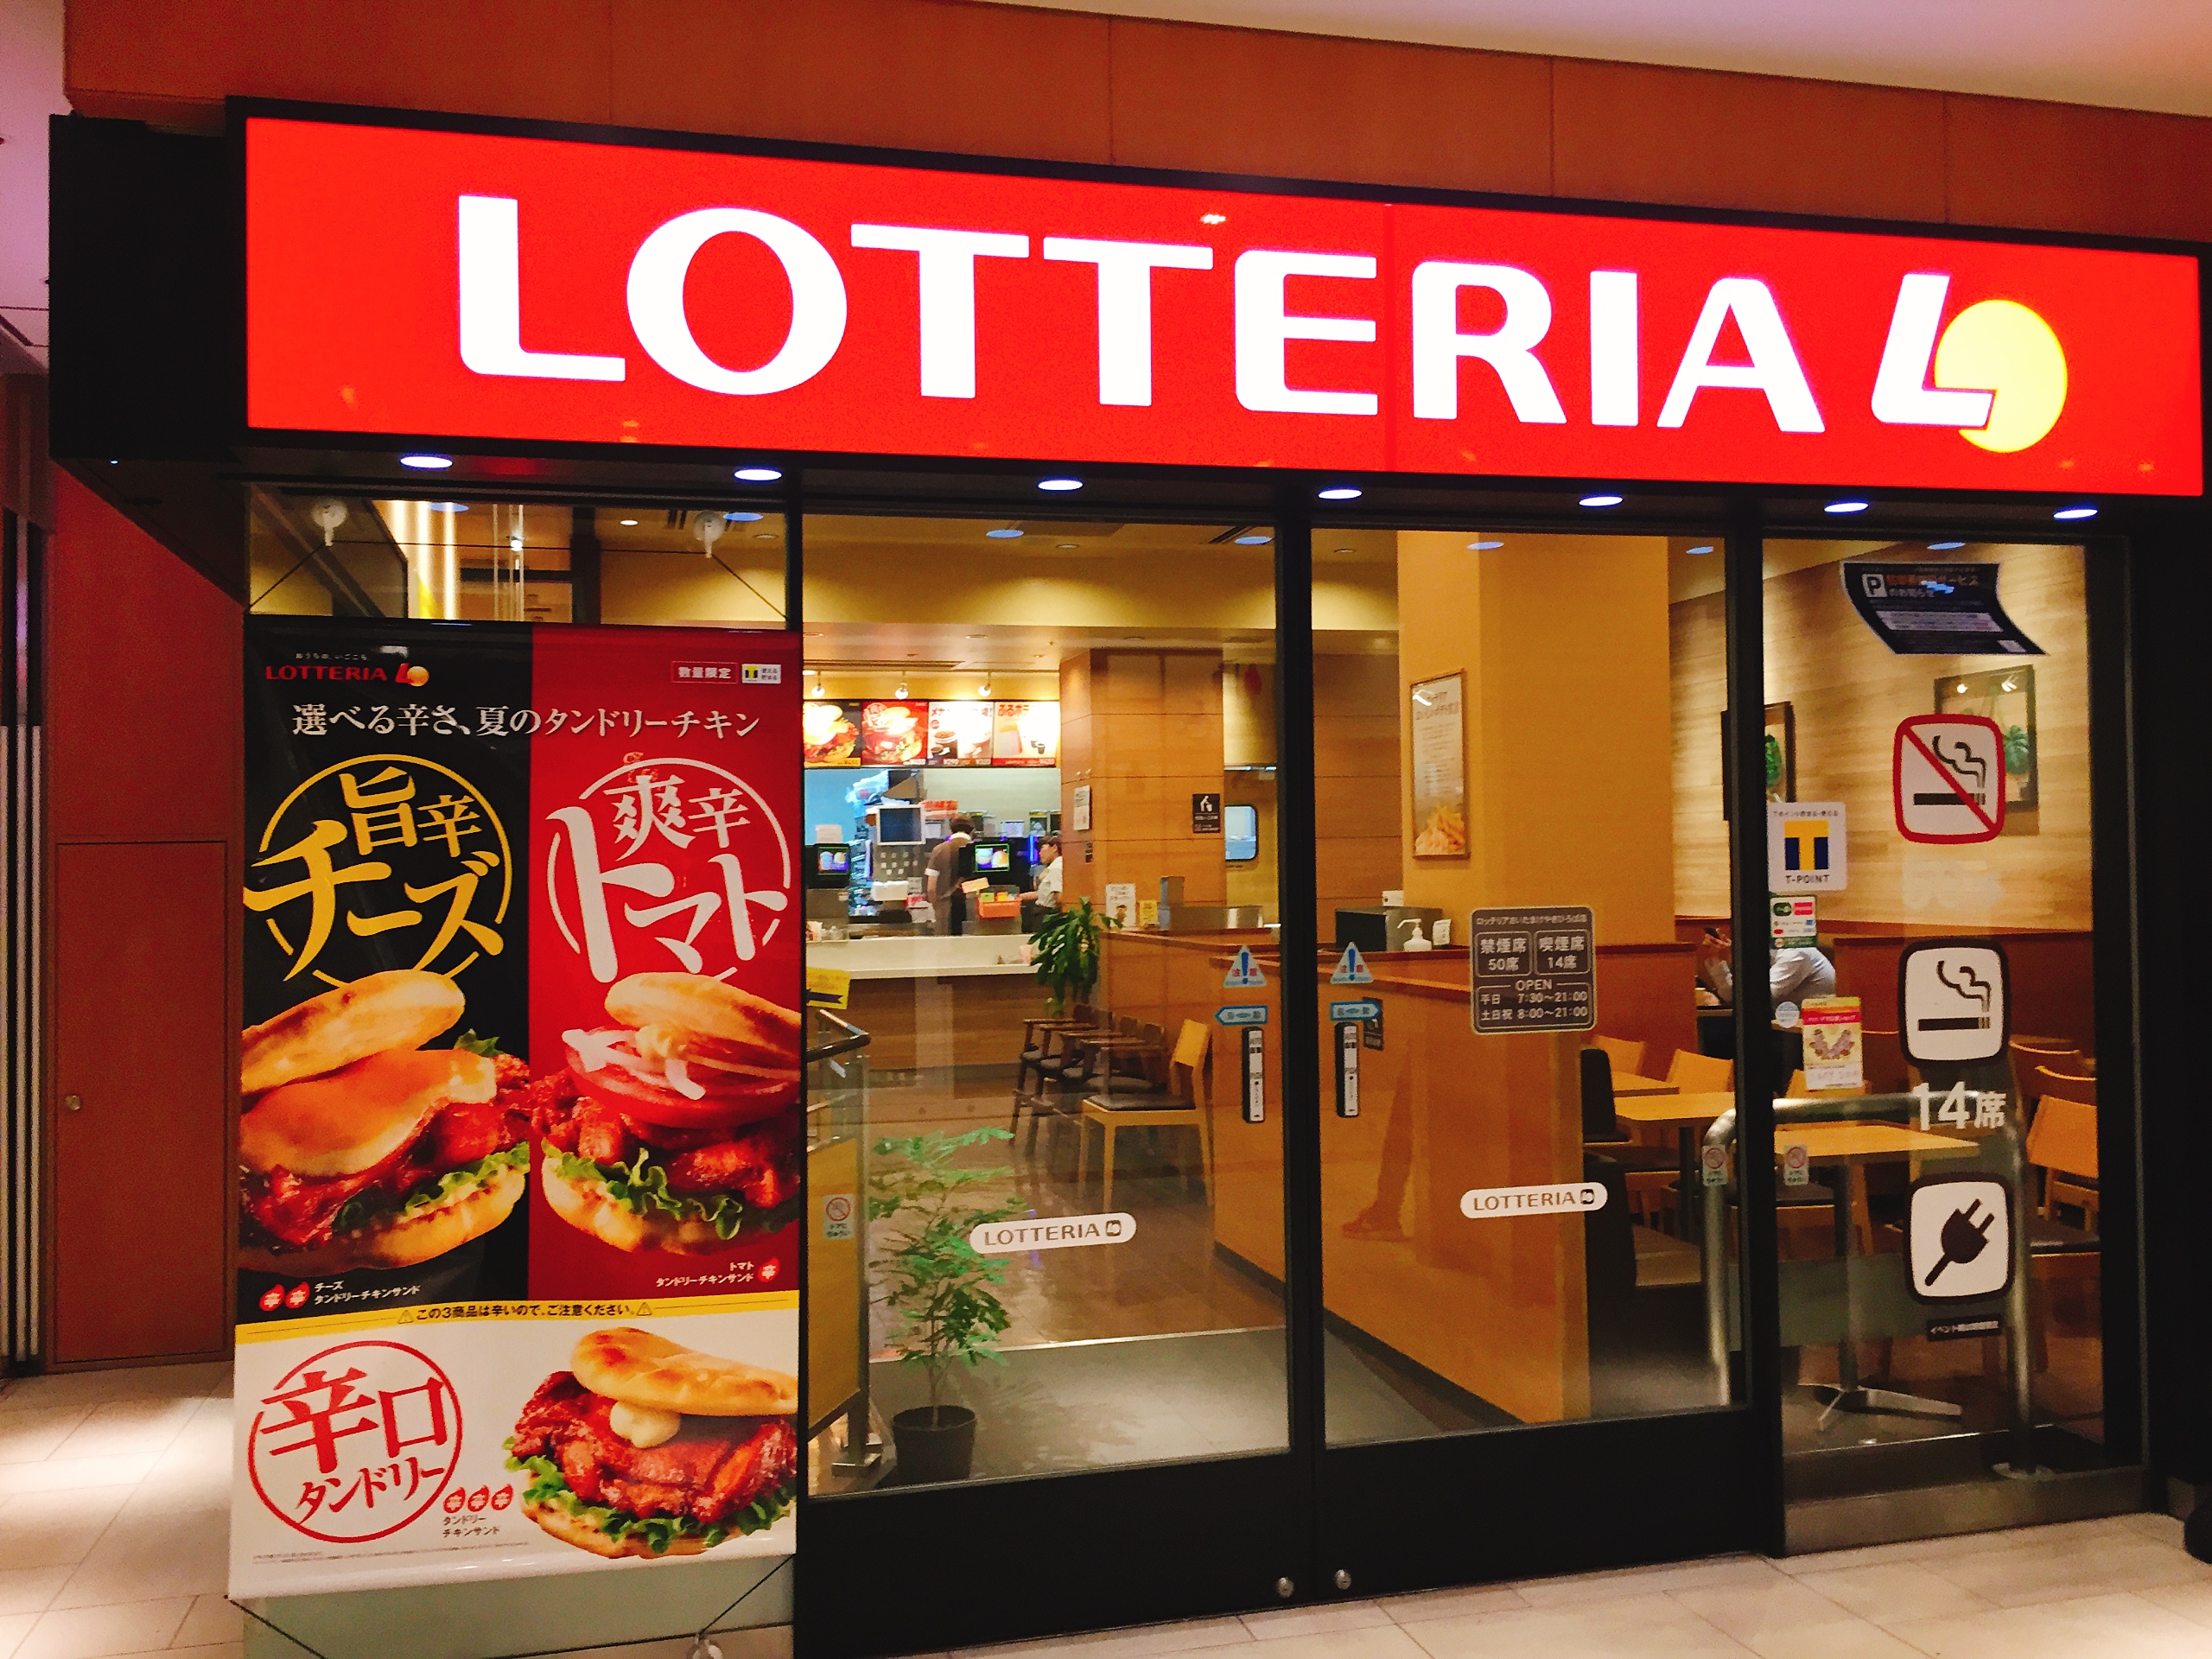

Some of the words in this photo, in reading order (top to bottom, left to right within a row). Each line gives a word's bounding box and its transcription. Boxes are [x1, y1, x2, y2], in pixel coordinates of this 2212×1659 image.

[459, 194, 1825, 432] LOTTERIA
[265, 665, 388, 680] LOTTERIA
[292, 702, 760, 740] 選べる辛さ、夏のタンドリーチキン
[340, 766, 481, 857] 旨辛
[605, 774, 751, 861] 爽辛
[1785, 874, 1830, 885] T-POINT
[243, 819, 504, 981] チーズ
[545, 806, 788, 982] トマト
[1480, 938, 1528, 954] 禁煙席
[1539, 936, 1586, 952] 喫煙席
[1488, 957, 1520, 971] 50席
[1548, 954, 1577, 969] 14席
[1515, 979, 1553, 991] OPEN
[1480, 994, 1501, 1006] 平日
[1480, 1008, 1513, 1021] 土日祝
[1911, 1080, 2006, 1131] 14席
[1473, 1192, 1576, 1211] LOTTERIA
[984, 1223, 1101, 1246] LOTTERIA
[315, 1280, 345, 1292] チーズ
[656, 1273, 754, 1287] タンドリーチキンサンド
[314, 1285, 422, 1305] タンドリーチキンサンド
[260, 1367, 448, 1474] 辛口
[297, 1455, 445, 1523] タンドリー
[443, 1514, 486, 1526] タンドリー
[442, 1526, 500, 1538] チキンサンド
